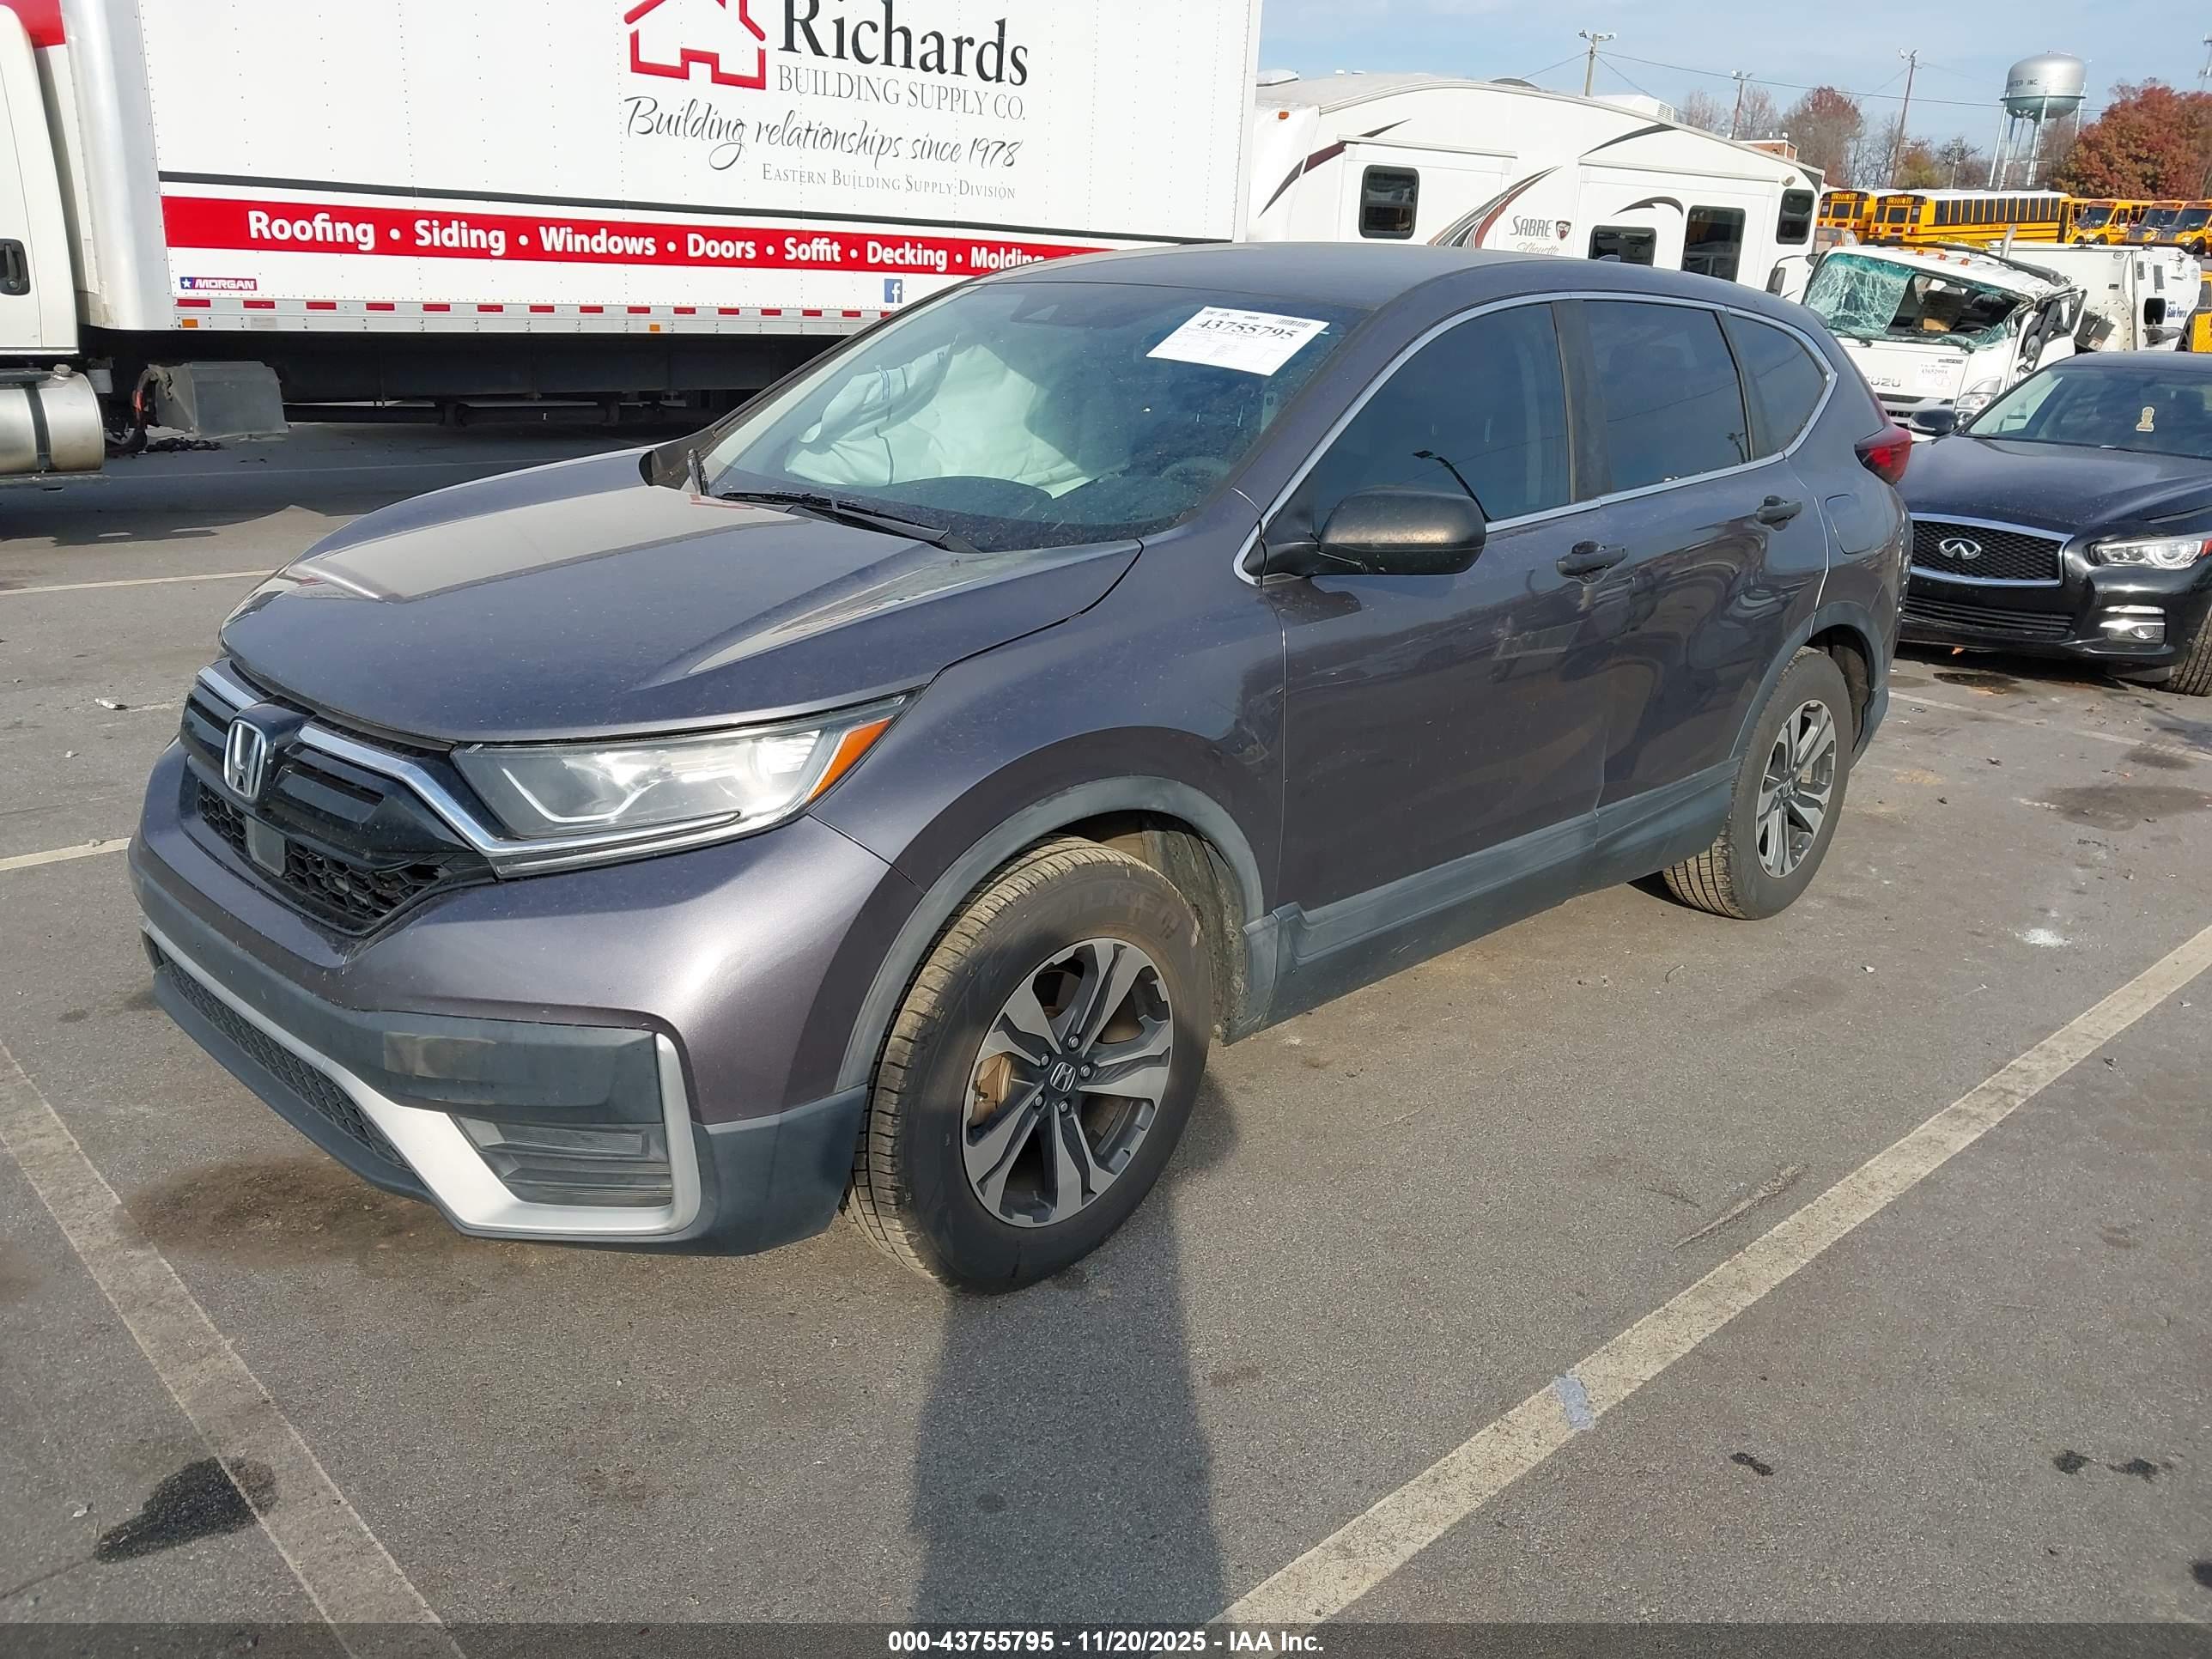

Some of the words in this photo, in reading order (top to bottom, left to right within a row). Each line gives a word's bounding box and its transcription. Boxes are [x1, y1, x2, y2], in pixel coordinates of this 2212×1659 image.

[778, 0, 1028, 86] Richards
[777, 64, 900, 105] BUILDING
[908, 82, 988, 116] SUPPLY
[994, 94, 1026, 121] CO.
[624, 95, 748, 170] Building
[755, 109, 903, 170] relationships
[910, 131, 962, 162] since
[969, 137, 1024, 168] 1978
[248, 210, 375, 251] Roofing
[414, 219, 507, 257] Siding
[538, 226, 656, 256] Windows
[686, 233, 756, 259] Doors
[784, 237, 842, 262] Soffit
[866, 240, 947, 272] Decking
[1509, 215, 1553, 238] SABRE
[194, 278, 255, 290] MORGAN
[1197, 318, 1299, 341] 43755795
[1867, 375, 1901, 387] UZU
